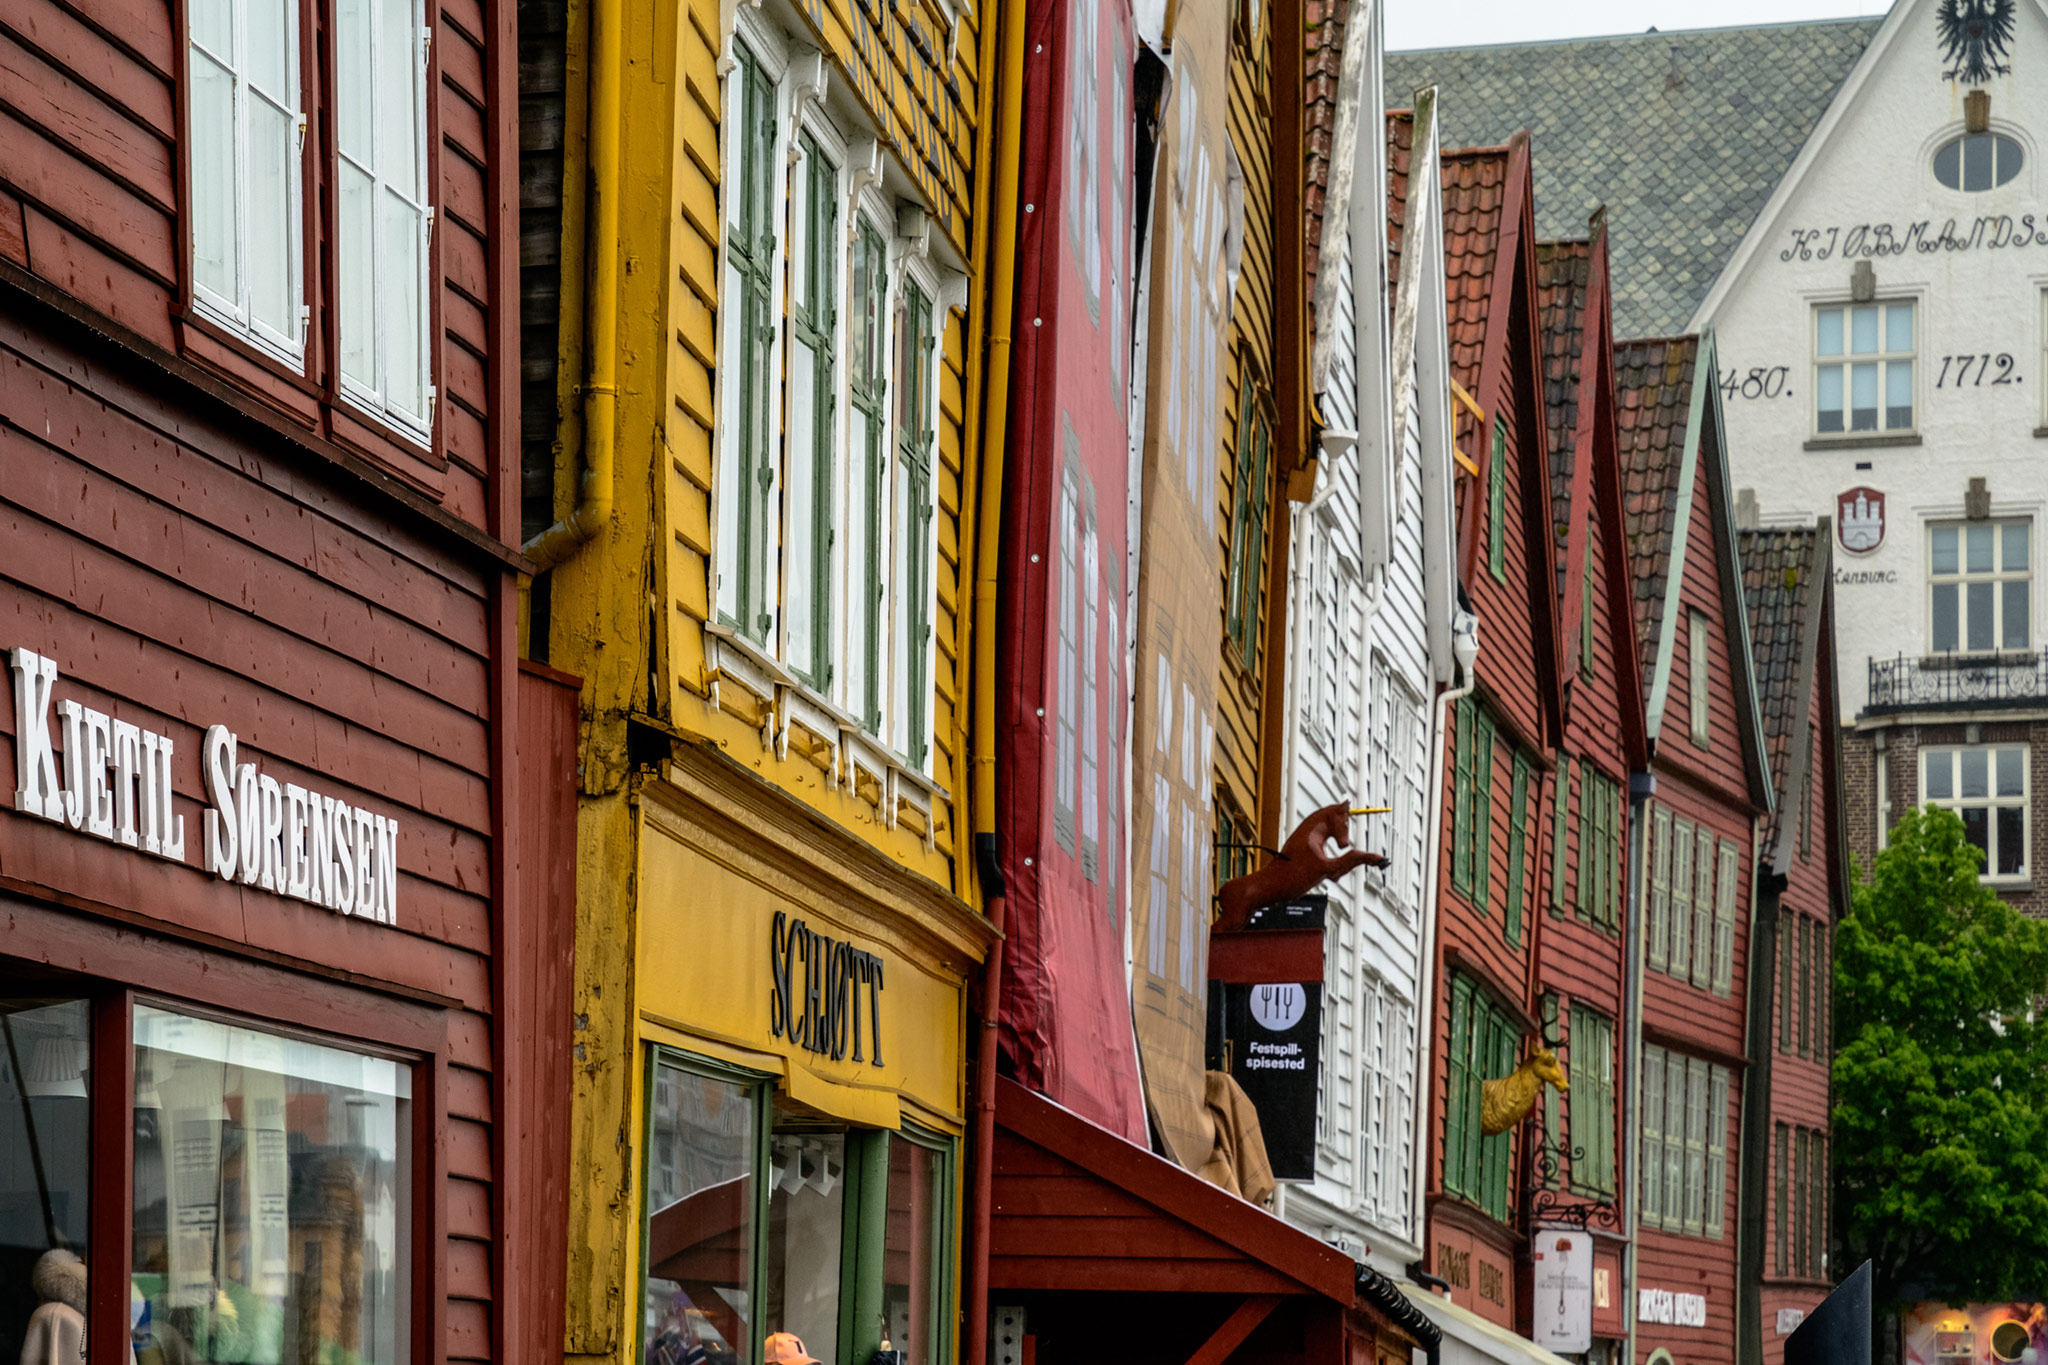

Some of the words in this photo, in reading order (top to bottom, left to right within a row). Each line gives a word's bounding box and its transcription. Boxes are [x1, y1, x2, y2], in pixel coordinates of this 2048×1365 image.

[1717, 365, 1793, 401] 480.
[1935, 352, 2023, 388] 1712.
[10, 646, 186, 863] KJETIL
[202, 723, 399, 926] SØRENSEN
[770, 909, 886, 1068] SCHJØTT
[1245, 1056, 1306, 1070] spisested
[1250, 1041, 1303, 1057] Festspill-
